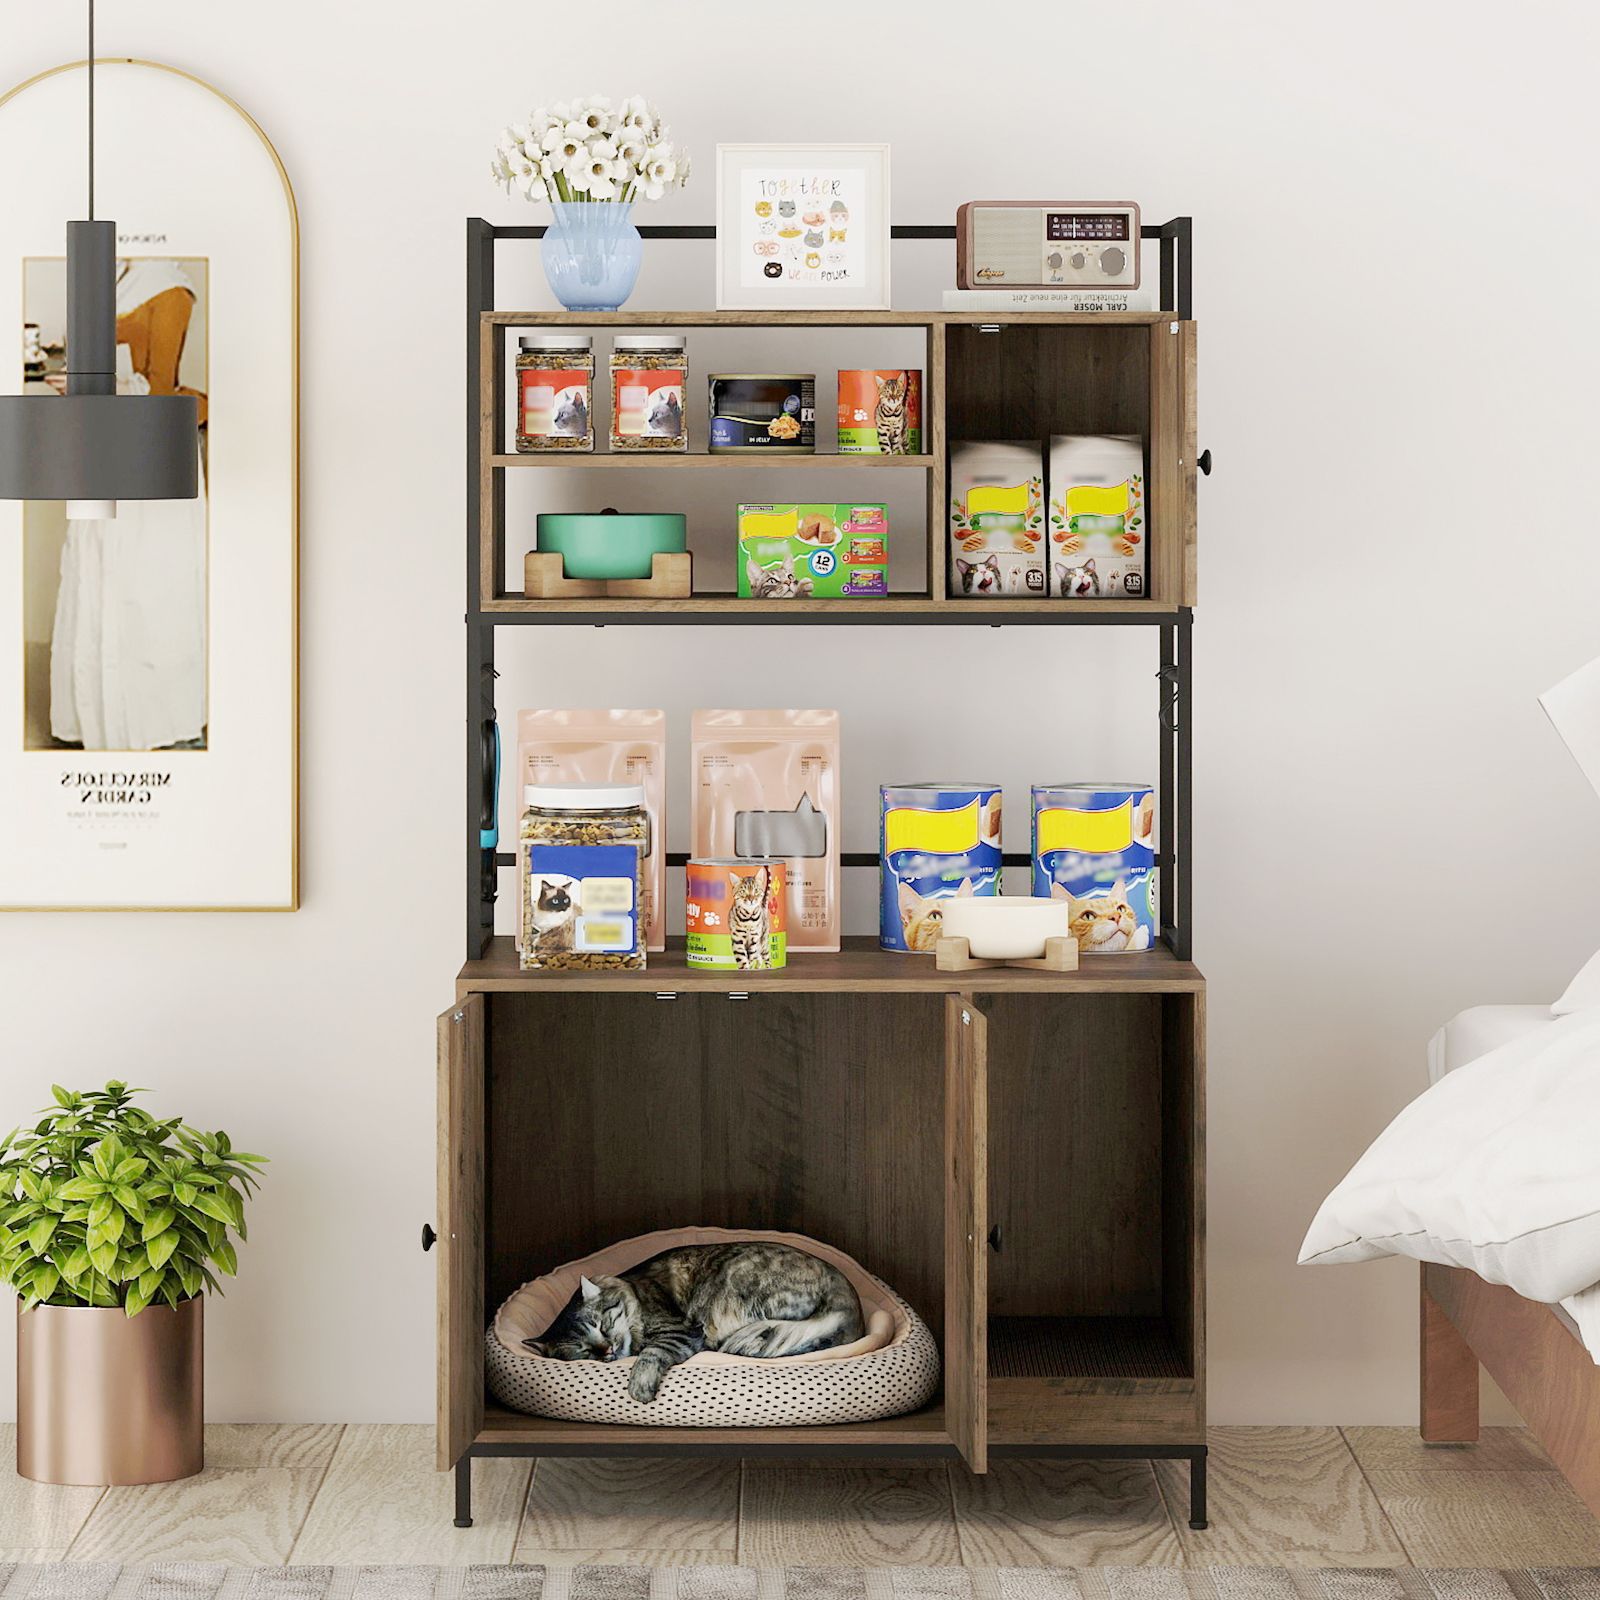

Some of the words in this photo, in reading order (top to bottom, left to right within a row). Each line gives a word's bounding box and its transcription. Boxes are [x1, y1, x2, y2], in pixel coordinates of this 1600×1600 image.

[1012, 294, 1028, 303] Zeit
[1030, 294, 1049, 302] neue
[1051, 294, 1068, 303] eine
[1070, 294, 1082, 303] für
[1084, 294, 1128, 303] Architektur
[1074, 303, 1103, 311] MOSER
[1106, 303, 1128, 311] CARL
[816, 555, 830, 567] 12
[1027, 571, 1043, 583] 3.15
[1126, 575, 1141, 586] 3.15
